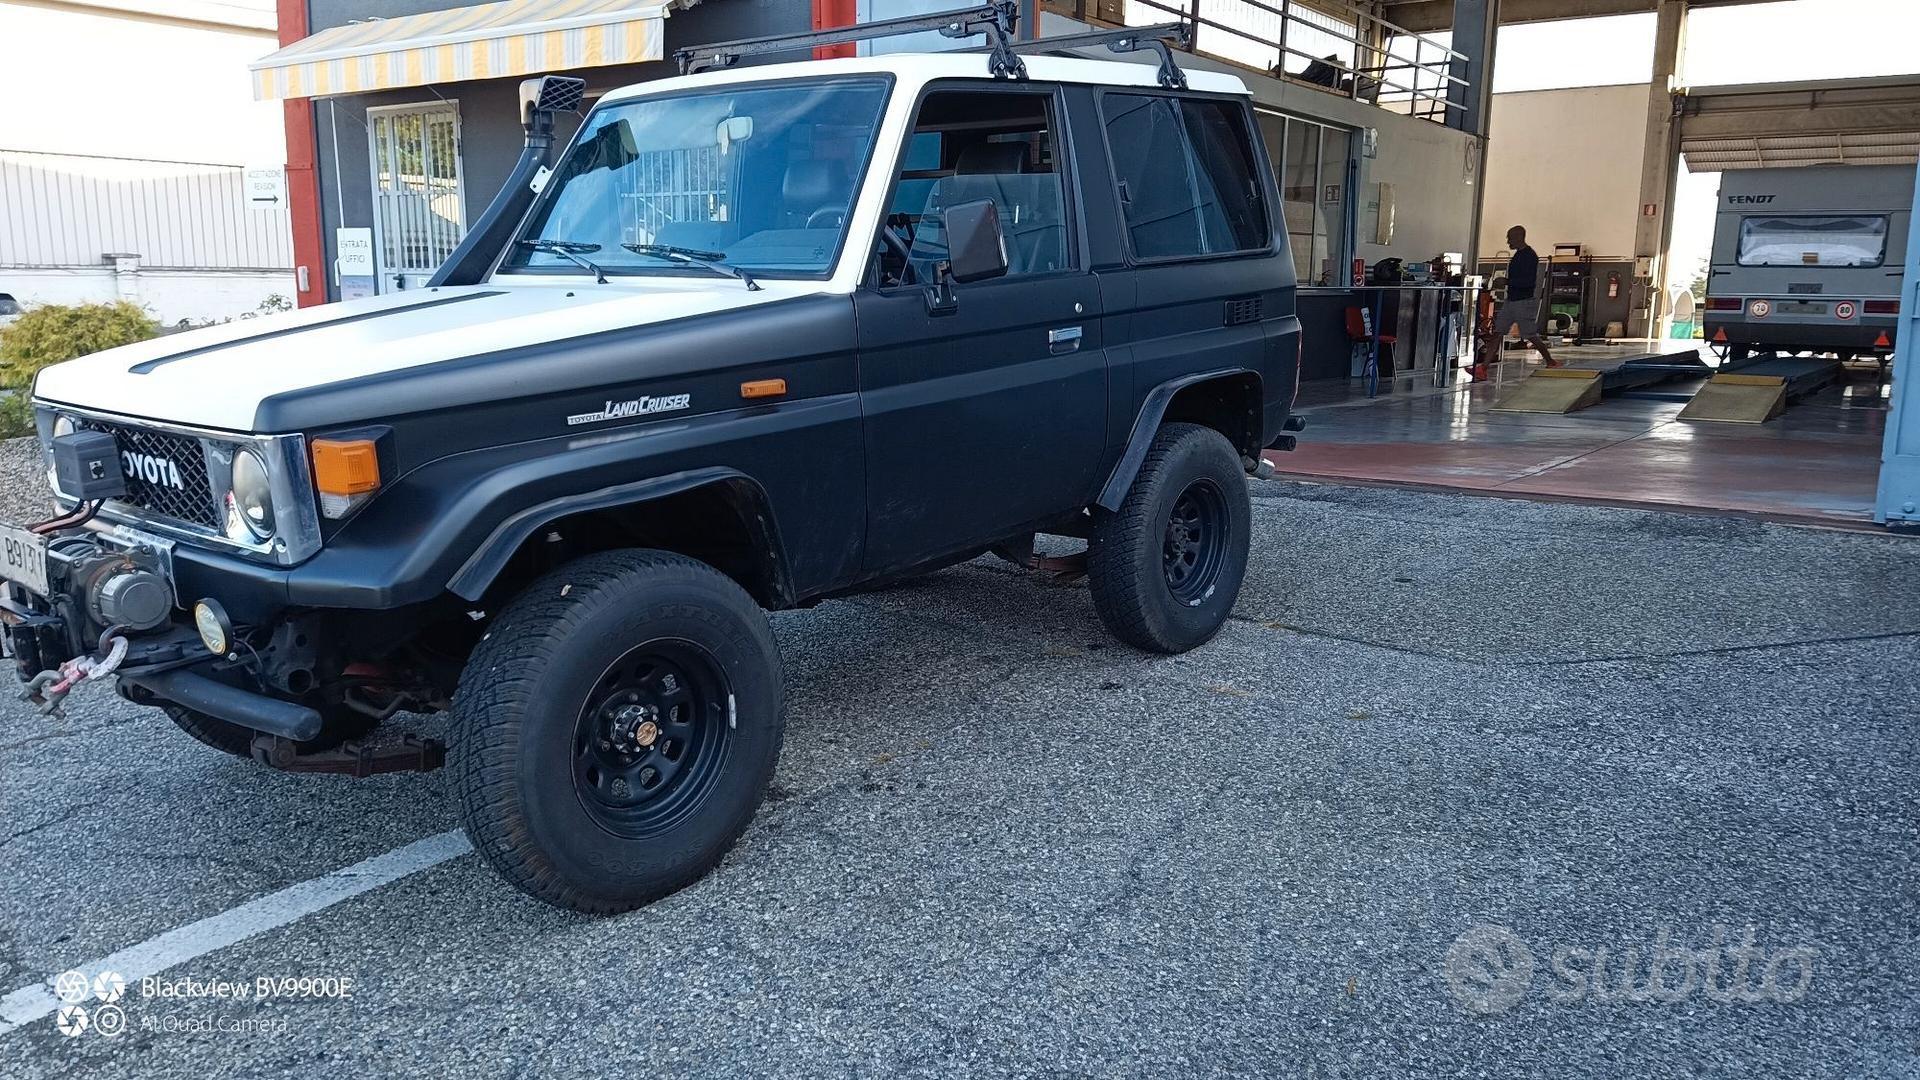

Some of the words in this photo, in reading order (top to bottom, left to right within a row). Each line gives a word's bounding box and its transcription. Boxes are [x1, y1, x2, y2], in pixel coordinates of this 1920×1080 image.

[1728, 194, 1776, 204] FENDT
[340, 240, 368, 248] ENTRATA
[569, 414, 601, 424] TOYOTA
[121, 450, 184, 490] OYOTA
